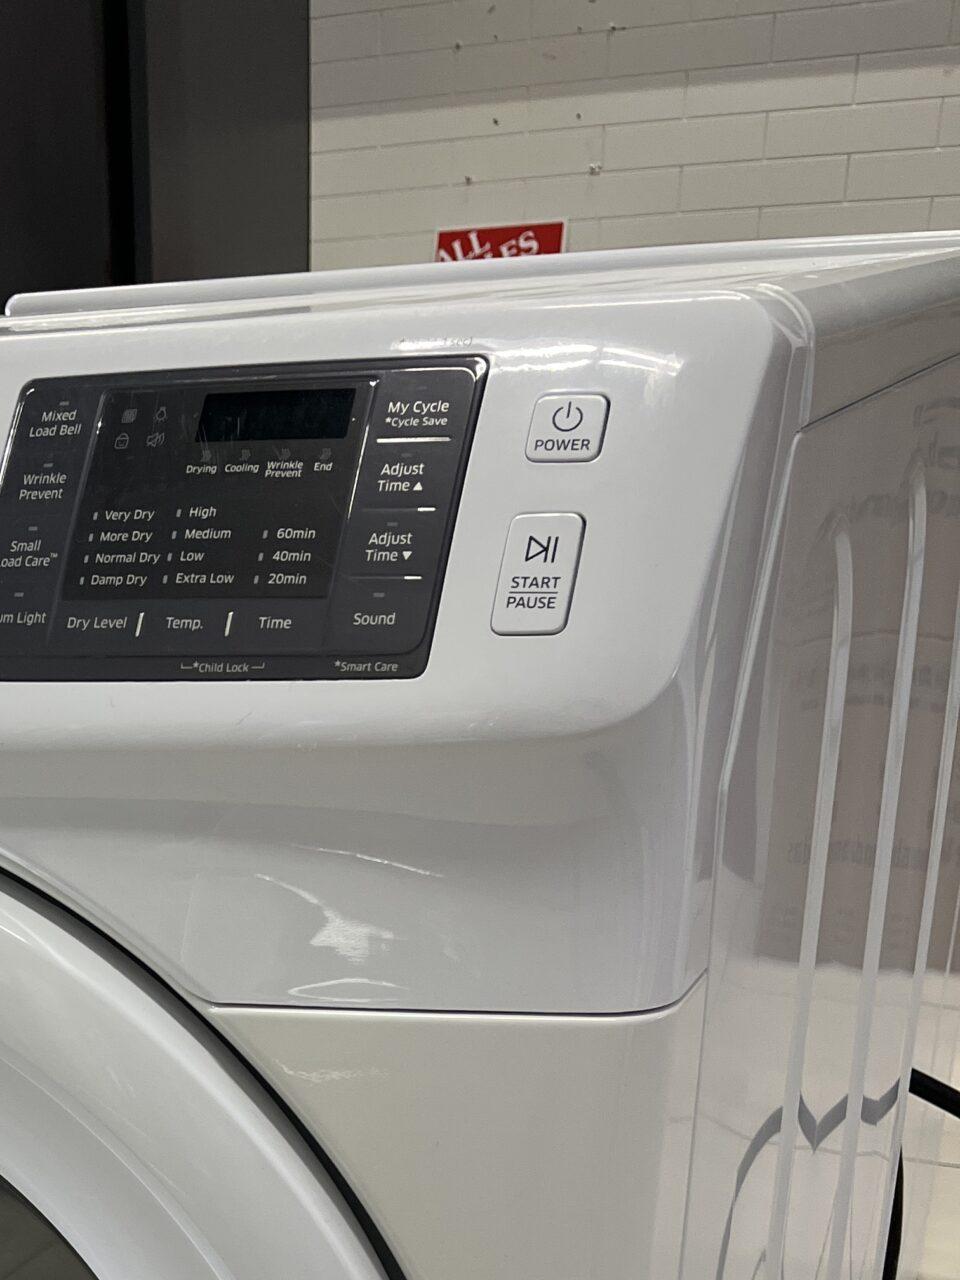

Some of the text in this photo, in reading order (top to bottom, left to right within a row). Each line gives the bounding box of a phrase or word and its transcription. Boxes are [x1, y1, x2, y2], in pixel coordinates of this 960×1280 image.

[388, 400, 450, 415] My Cycle
[41, 409, 78, 422] Mixed
[422, 416, 448, 427] Save
[29, 423, 82, 438] Load Bell
[534, 438, 591, 451] POWER
[186, 464, 218, 475] Drying
[224, 463, 260, 474] Cooling
[267, 460, 304, 470] Wrinkle
[313, 461, 333, 472] End
[380, 463, 425, 478] Adjust
[23, 472, 67, 486] Wrinkle
[265, 469, 302, 478] Prevent
[377, 479, 411, 492] Time
[19, 488, 63, 500] Prevent
[105, 509, 155, 522] Very Dry
[189, 506, 217, 519] High
[100, 530, 153, 543] More Dry
[184, 528, 232, 540] Medium
[276, 528, 316, 540] 60min
[368, 532, 413, 548] Adjust
[10, 539, 41, 552] Small
[95, 551, 161, 565] Normal Dry
[180, 550, 205, 562] Low
[272, 550, 311, 562] 40min
[365, 549, 398, 562] Time
[90, 574, 147, 587] Damp Dry
[175, 572, 235, 584] Extra Low
[268, 573, 307, 585] 20min
[510, 576, 561, 589] START
[506, 596, 557, 609] PAUSE
[16, 612, 47, 626] Light
[67, 616, 128, 631] Dry Level
[166, 617, 204, 631] Temp.
[258, 616, 292, 629] Time
[353, 612, 396, 626] Sound
[226, 662, 249, 673] Lock
[374, 661, 399, 672] Care
